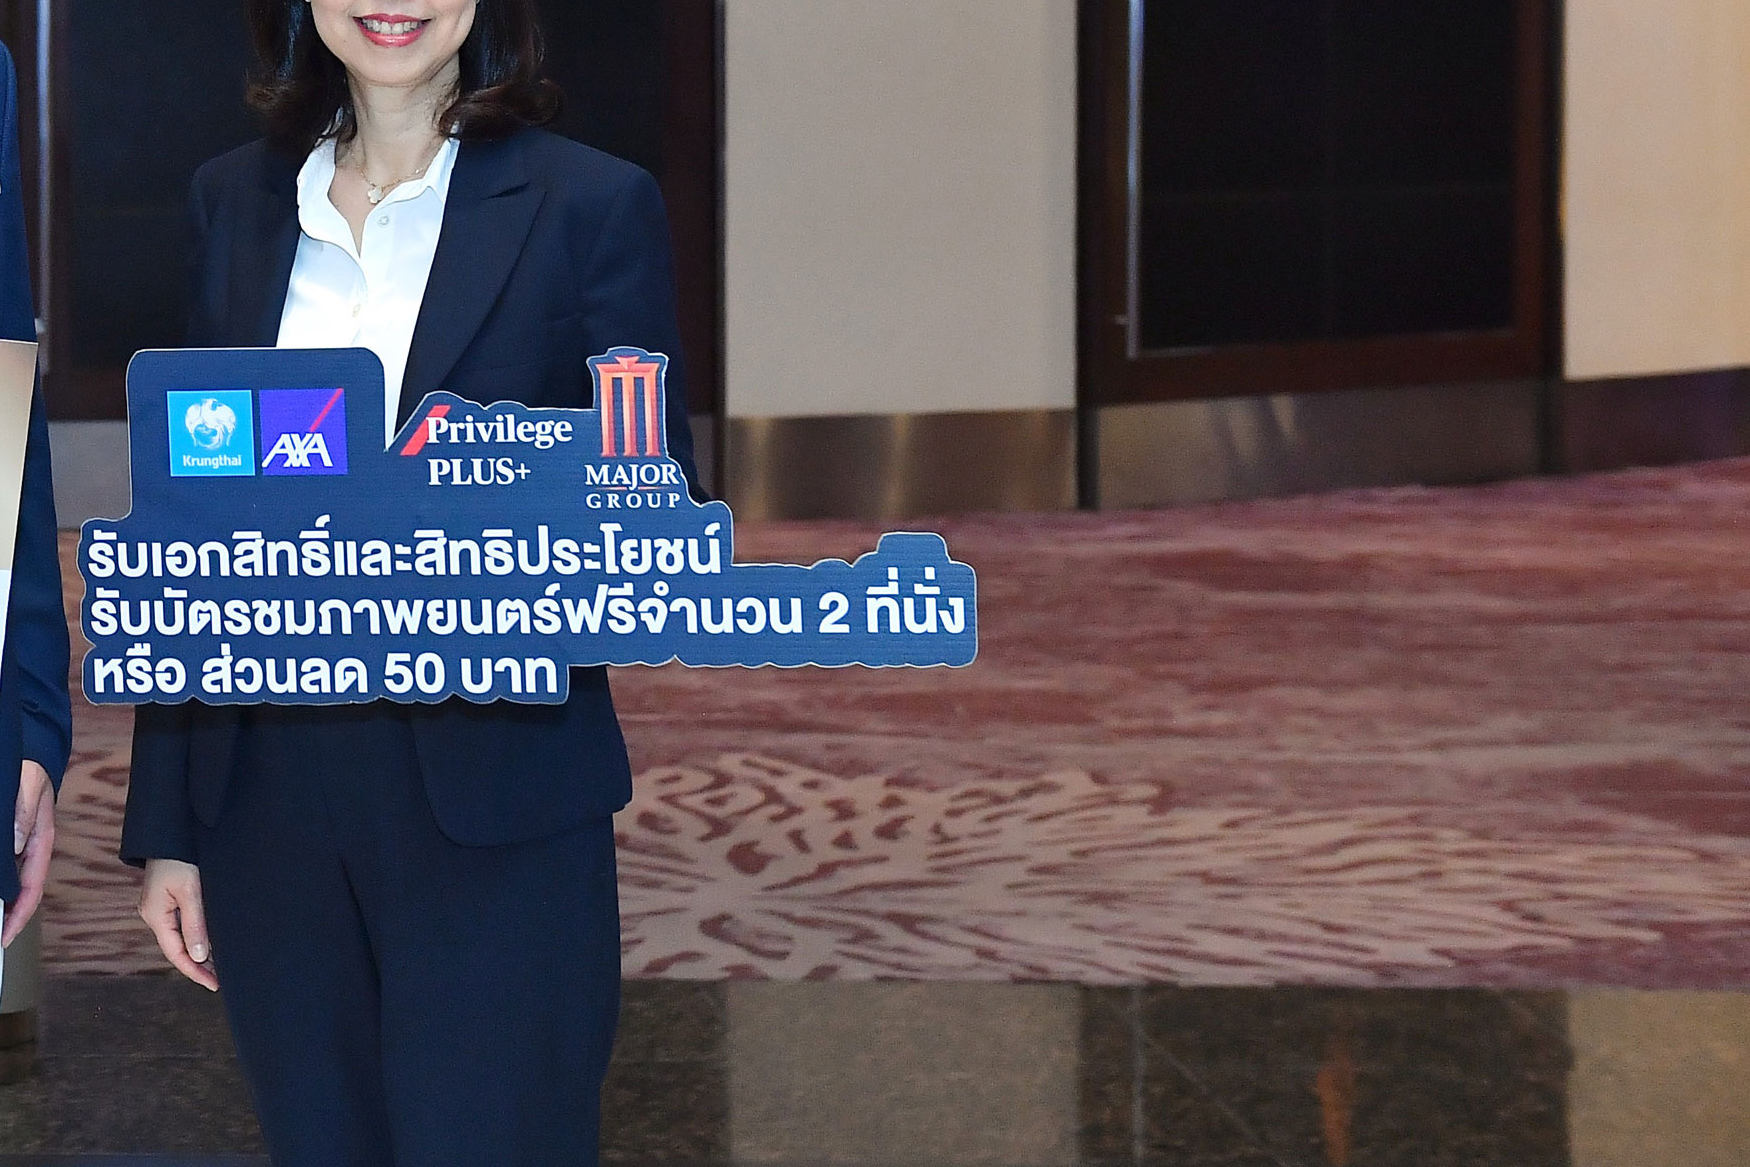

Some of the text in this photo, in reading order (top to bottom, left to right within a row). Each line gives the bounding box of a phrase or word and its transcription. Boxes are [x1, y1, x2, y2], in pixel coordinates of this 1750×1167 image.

[425, 414, 573, 449] Privilege
[182, 454, 242, 469] Krungthai
[261, 432, 333, 468] AXA
[427, 457, 531, 486] PLUS+
[584, 463, 680, 490] MAJOR
[585, 492, 681, 509] GROUP
[88, 514, 722, 578] รับเอกสิทธิ์และสิทธิประโยชน์
[90, 566, 966, 636] รับบัตรชมภาพยนตร์ฟรีจำนวน 2 ที่นั่ง
[93, 642, 558, 694] หรือ ส่วนลด 50 บาท
